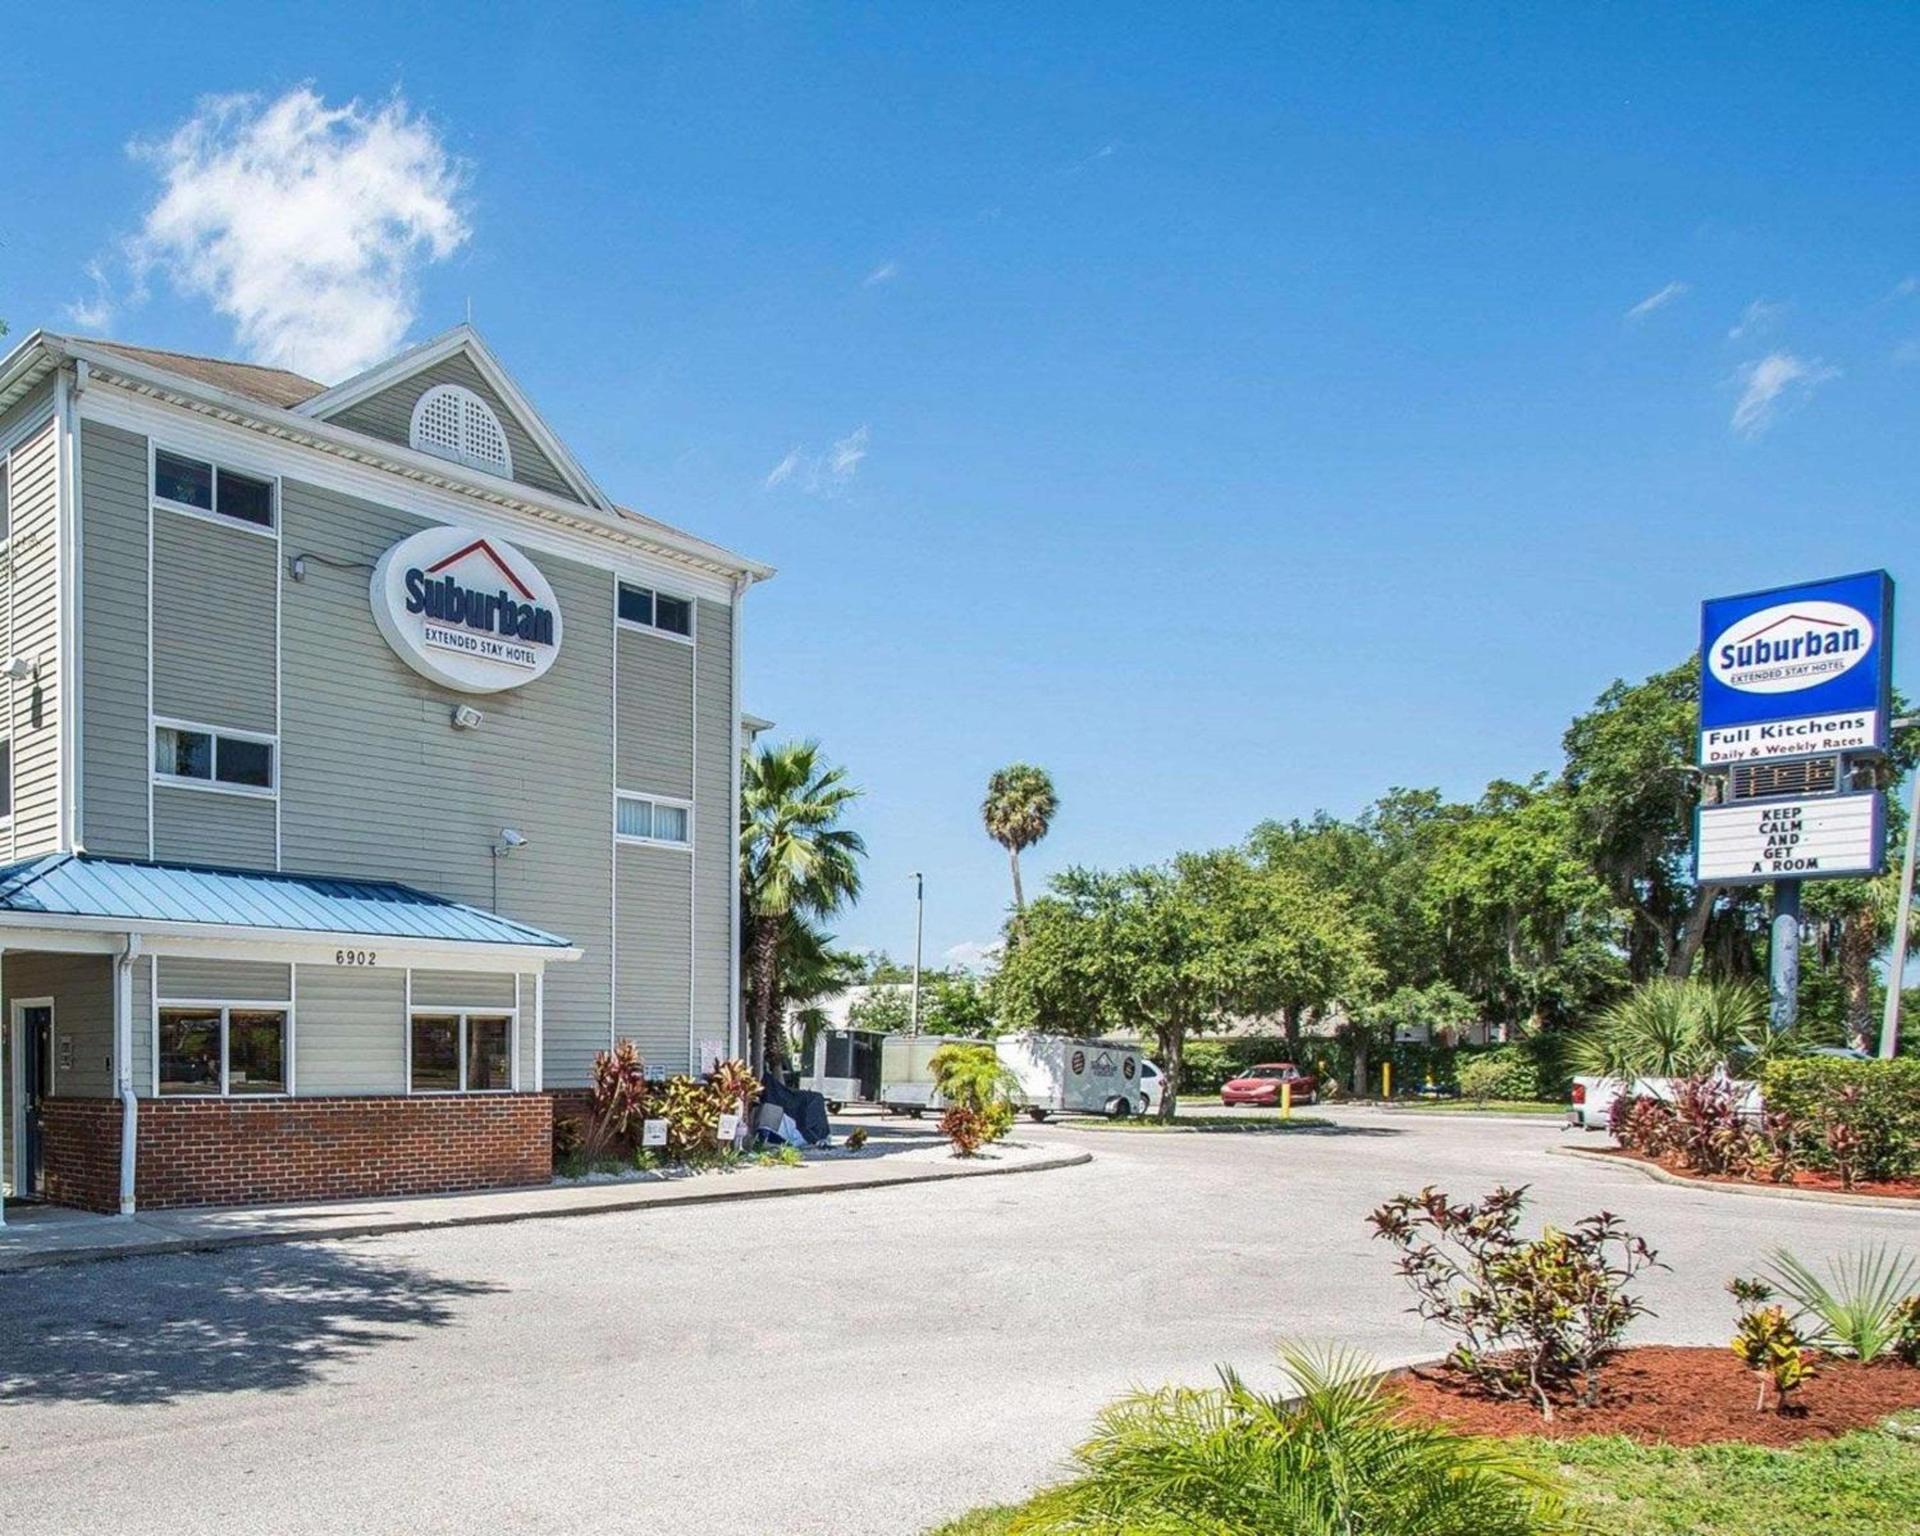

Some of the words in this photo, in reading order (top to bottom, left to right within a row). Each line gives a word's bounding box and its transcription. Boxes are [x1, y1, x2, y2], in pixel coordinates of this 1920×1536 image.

[405, 568, 554, 646] Suburban
[425, 627, 478, 650] EXTENDED
[480, 641, 503, 656] STAY
[506, 648, 536, 664] HOTEL
[1720, 627, 1860, 670] Suburban
[1730, 669, 1782, 684] EXTENDED
[1785, 666, 1809, 677] STAY
[1813, 660, 1846, 672] HOTEL
[1709, 729, 1750, 745] Full
[1760, 717, 1865, 739] Kitchens
[1710, 749, 1744, 761] Daily
[1750, 747, 1760, 757] &
[1766, 741, 1818, 755] Weekly
[1823, 736, 1864, 748] Rates
[1762, 807, 1802, 821] KEEP
[1759, 820, 1803, 834] CALM
[1767, 833, 1800, 846] AND
[1763, 847, 1794, 859] GET
[1752, 862, 1762, 873] A
[1772, 858, 1819, 872] ROOM
[336, 950, 376, 965] 6902
